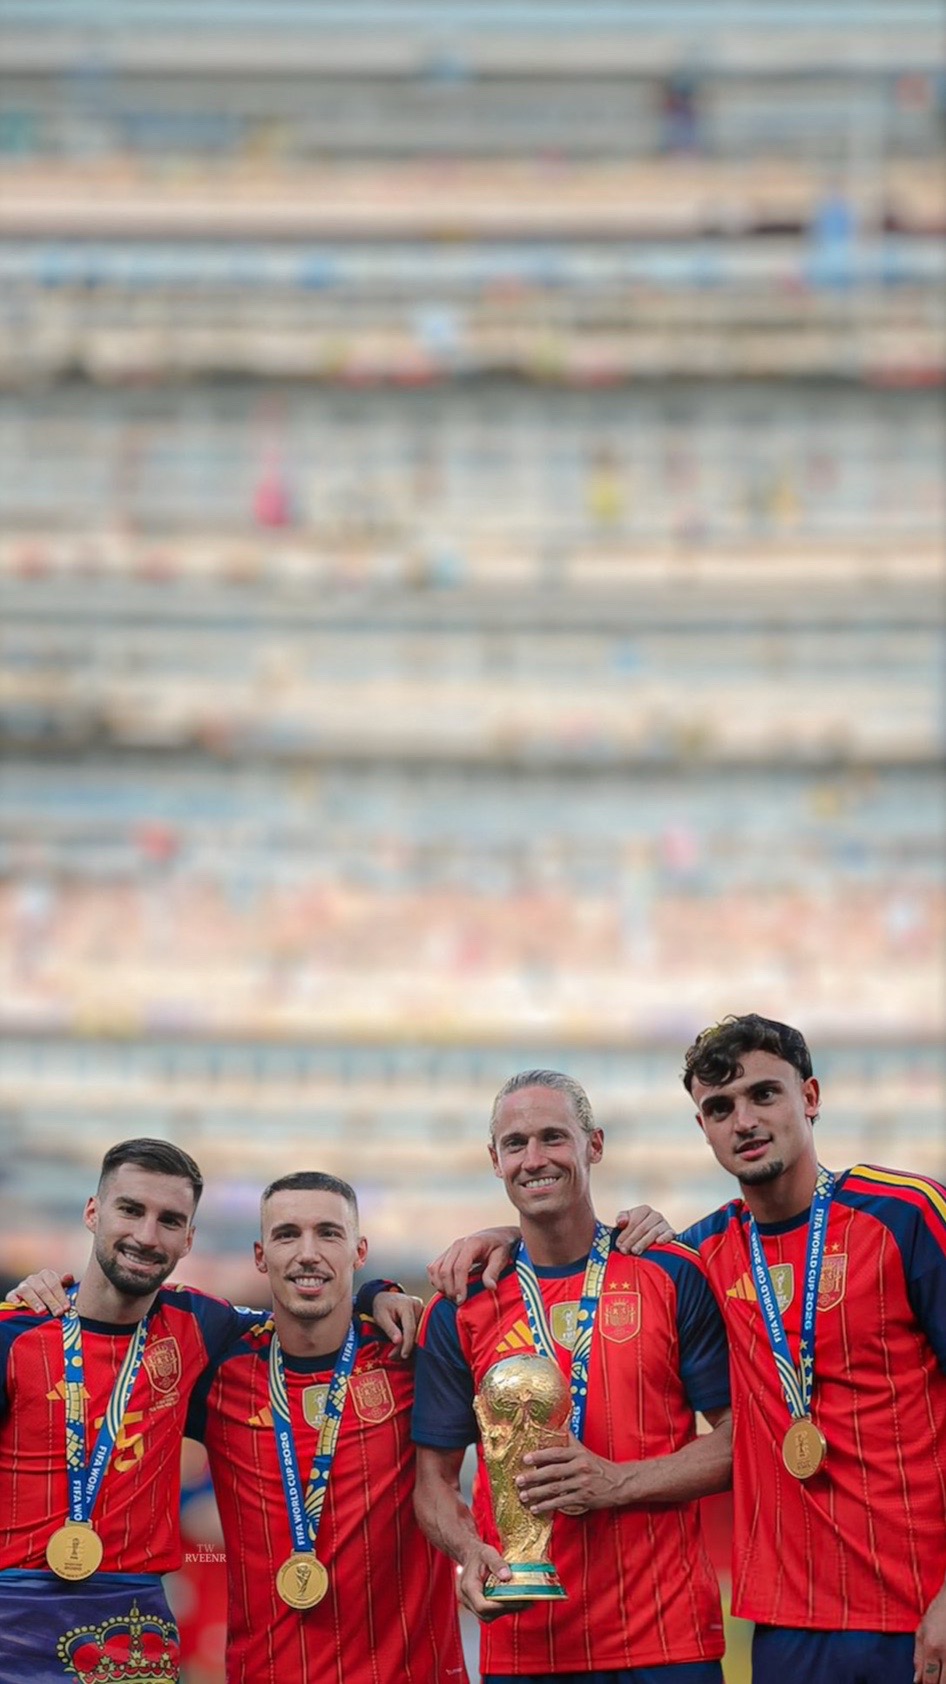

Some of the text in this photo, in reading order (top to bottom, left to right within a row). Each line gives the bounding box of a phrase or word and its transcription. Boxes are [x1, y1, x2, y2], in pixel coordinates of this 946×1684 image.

[756, 1265, 766, 1284] CUP
[804, 1208, 825, 1330] FIFA WORLD CUP 2026
[761, 1284, 776, 1321] WORLD
[771, 1320, 782, 1343] FIFA
[341, 1342, 353, 1362] FIFA
[93, 1445, 108, 1467] FIFA
[73, 1480, 82, 1503] FIFA
[280, 1431, 305, 1546] FIFA WORLD CUP 2026
